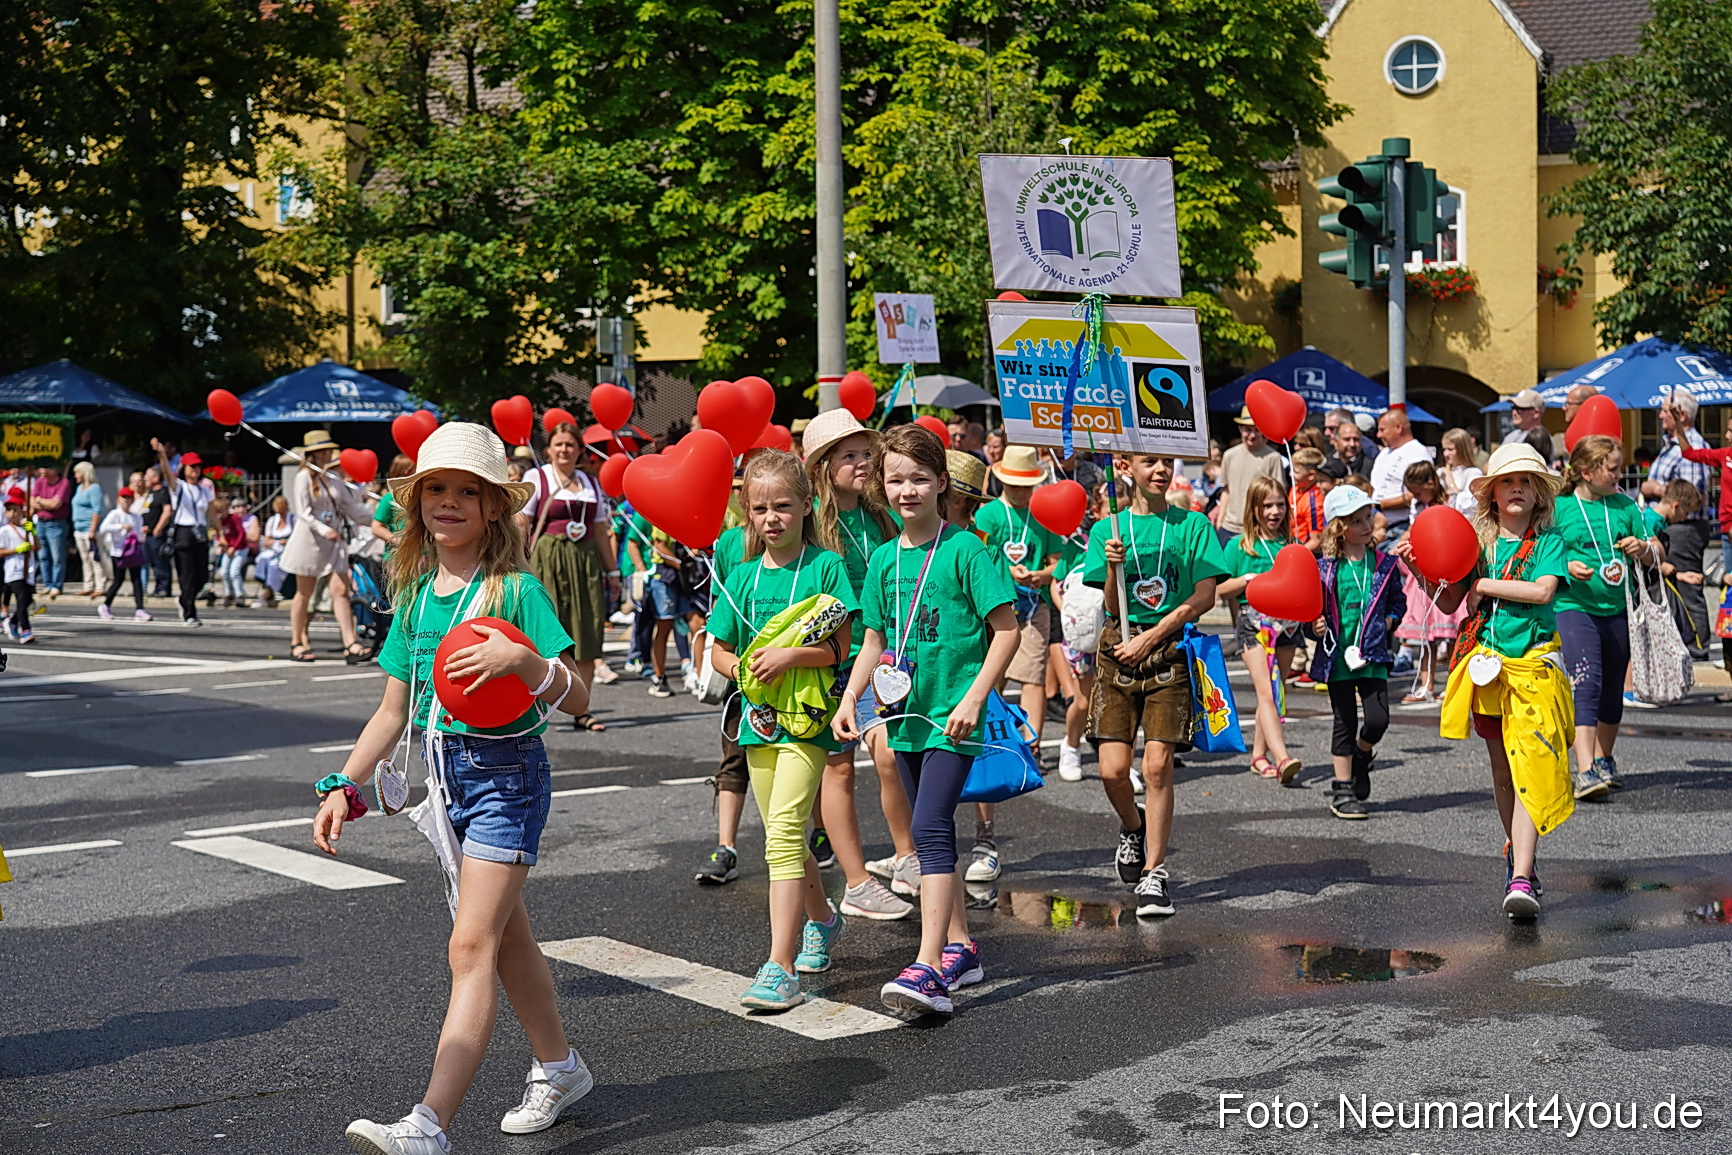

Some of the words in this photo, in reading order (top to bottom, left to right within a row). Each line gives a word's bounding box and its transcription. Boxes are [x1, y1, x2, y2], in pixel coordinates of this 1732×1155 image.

[1016, 161, 1089, 214] UMWELTSCHULE
[1090, 166, 1104, 178] IN
[1104, 173, 1139, 218] EUROPA
[1016, 219, 1075, 285] INTERNATIONALE
[1078, 271, 1119, 287] AGENDA
[1117, 223, 1141, 274] 21-SCHULE
[1000, 359, 1032, 376] Wir
[1038, 362, 1083, 378] sin
[1001, 377, 1126, 405] Fairtade
[15, 425, 52, 436] Schule
[1140, 416, 1193, 430] FAIRTRADE
[7, 441, 59, 452] Wolfstein
